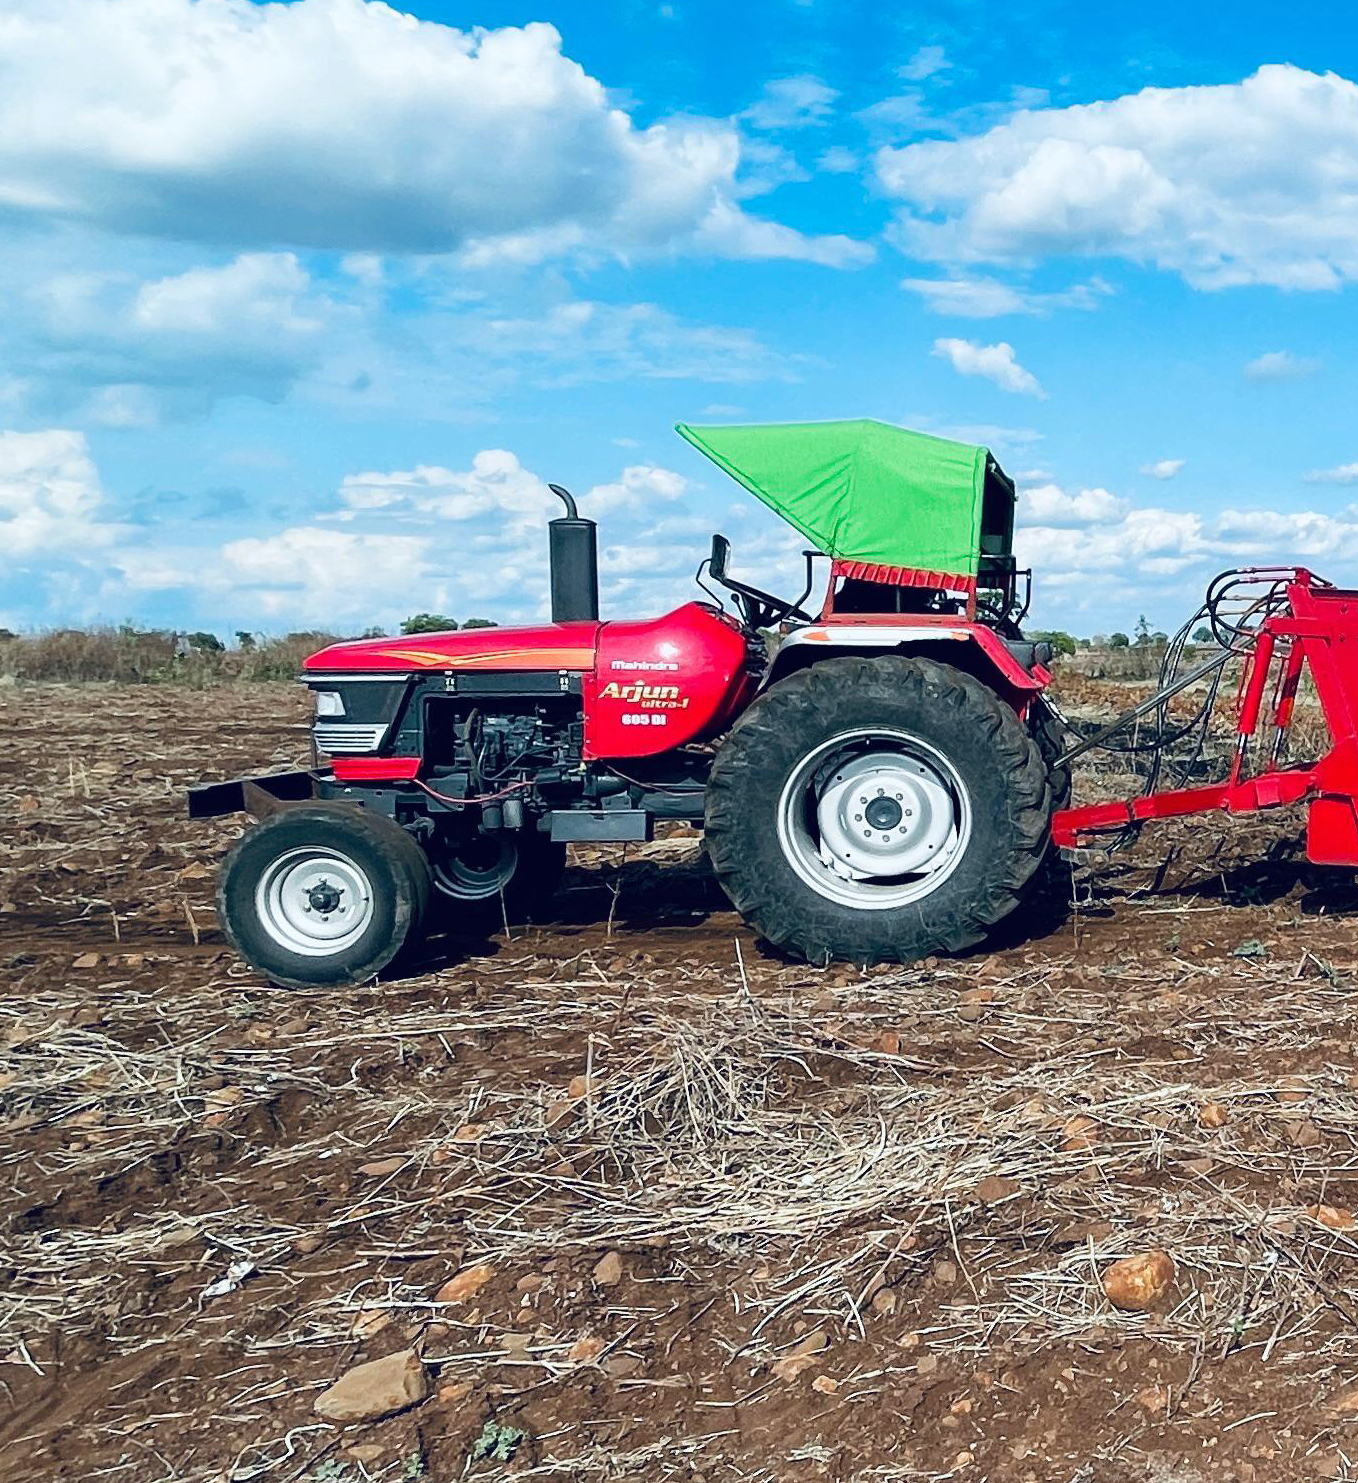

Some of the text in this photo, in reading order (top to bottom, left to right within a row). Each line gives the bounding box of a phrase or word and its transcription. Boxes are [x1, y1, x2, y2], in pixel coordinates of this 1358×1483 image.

[599, 680, 679, 702] Arjun
[621, 714, 667, 725] 605 DI
